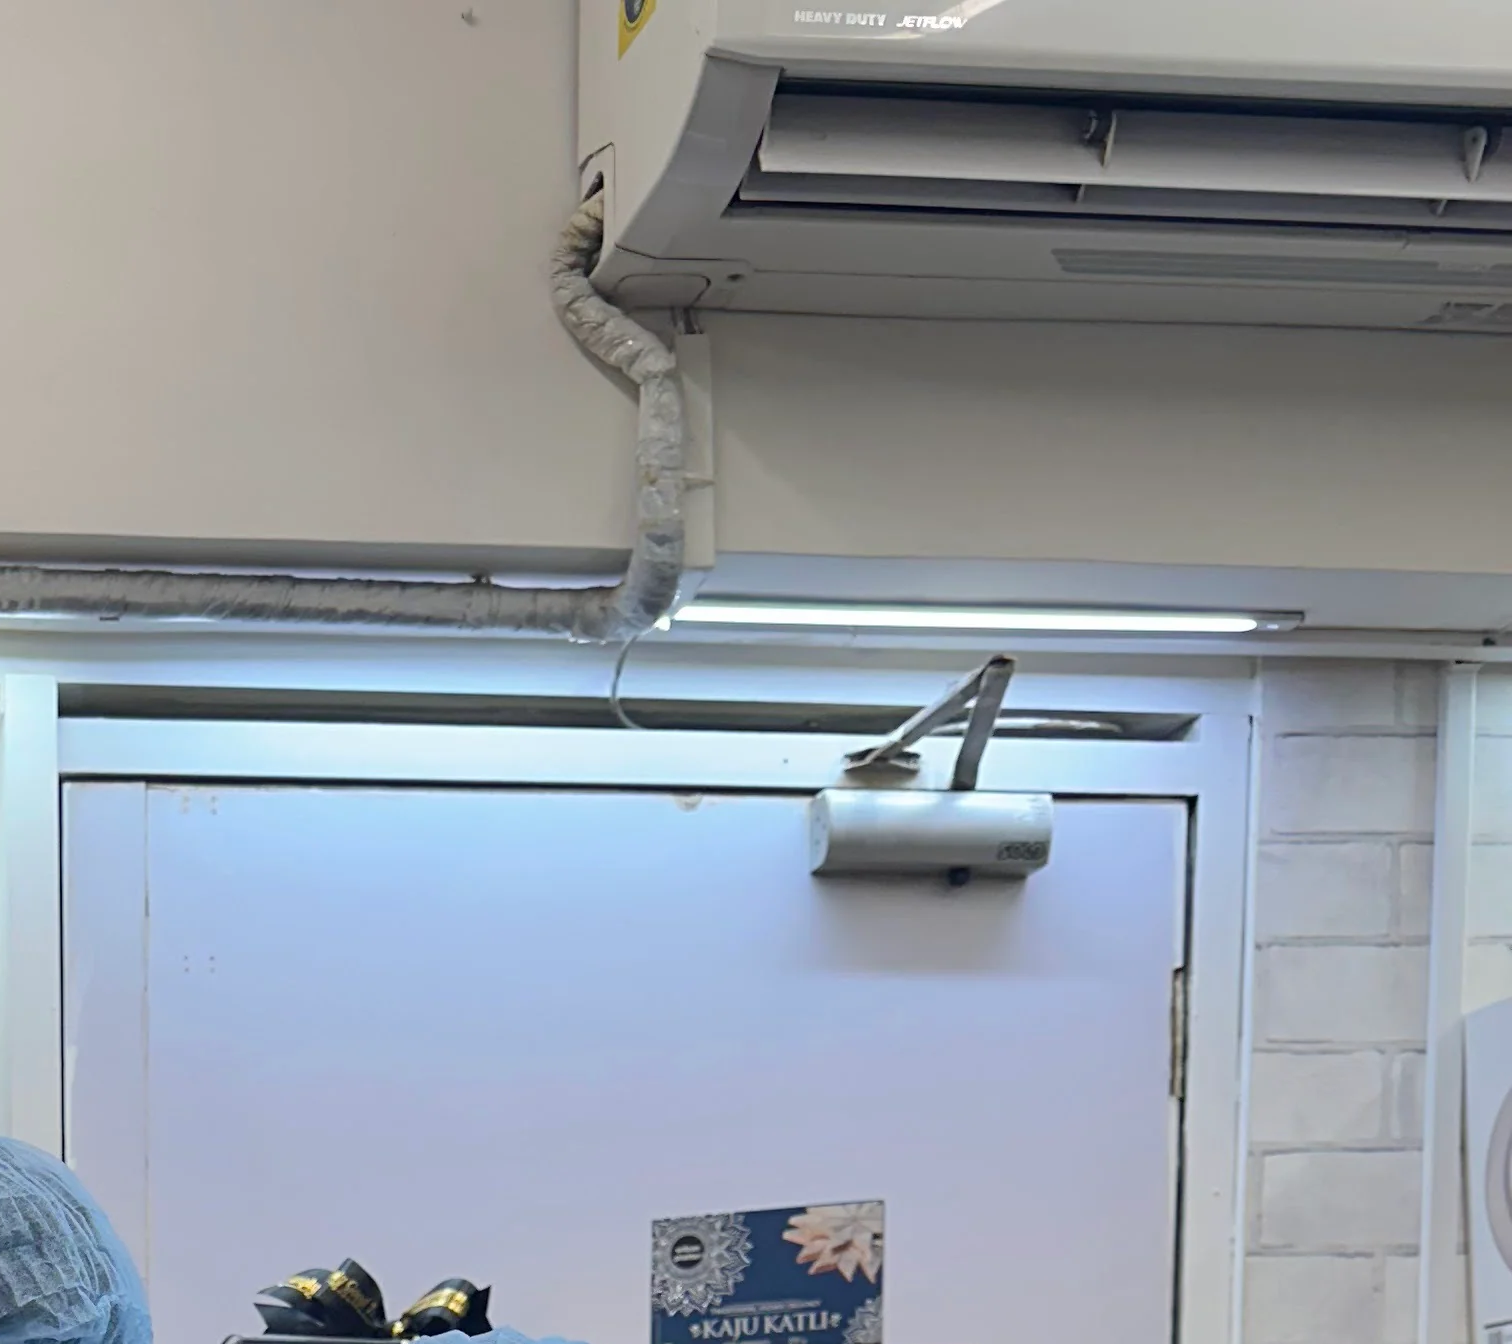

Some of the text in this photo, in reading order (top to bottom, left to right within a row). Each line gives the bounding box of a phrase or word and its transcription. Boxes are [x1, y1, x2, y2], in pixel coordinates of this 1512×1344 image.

[794, 10, 968, 29] HEAVY DUTY JETFLOW
[702, 1311, 828, 1341] KAJU KATLI
